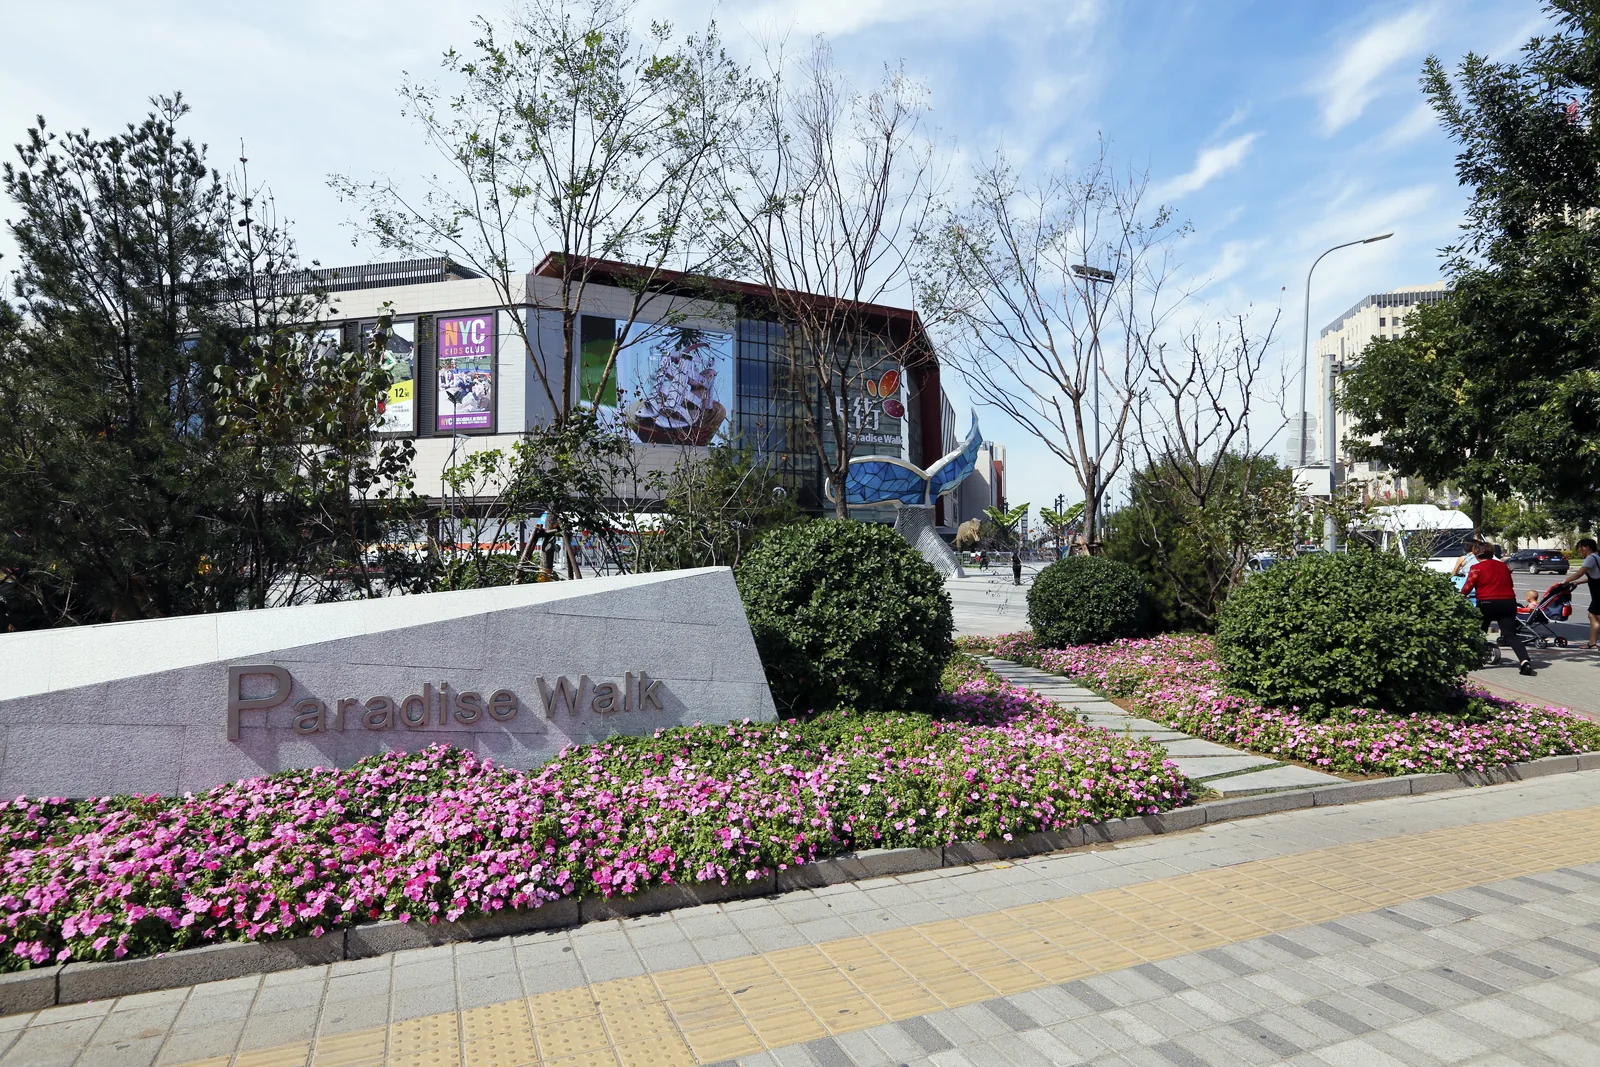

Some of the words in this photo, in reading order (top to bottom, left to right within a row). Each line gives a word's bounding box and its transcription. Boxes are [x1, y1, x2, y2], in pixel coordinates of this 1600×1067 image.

[445, 319, 485, 346] NYC
[465, 346, 485, 354] CLUB
[227, 664, 518, 741] Paradise
[535, 670, 664, 719] Walk
